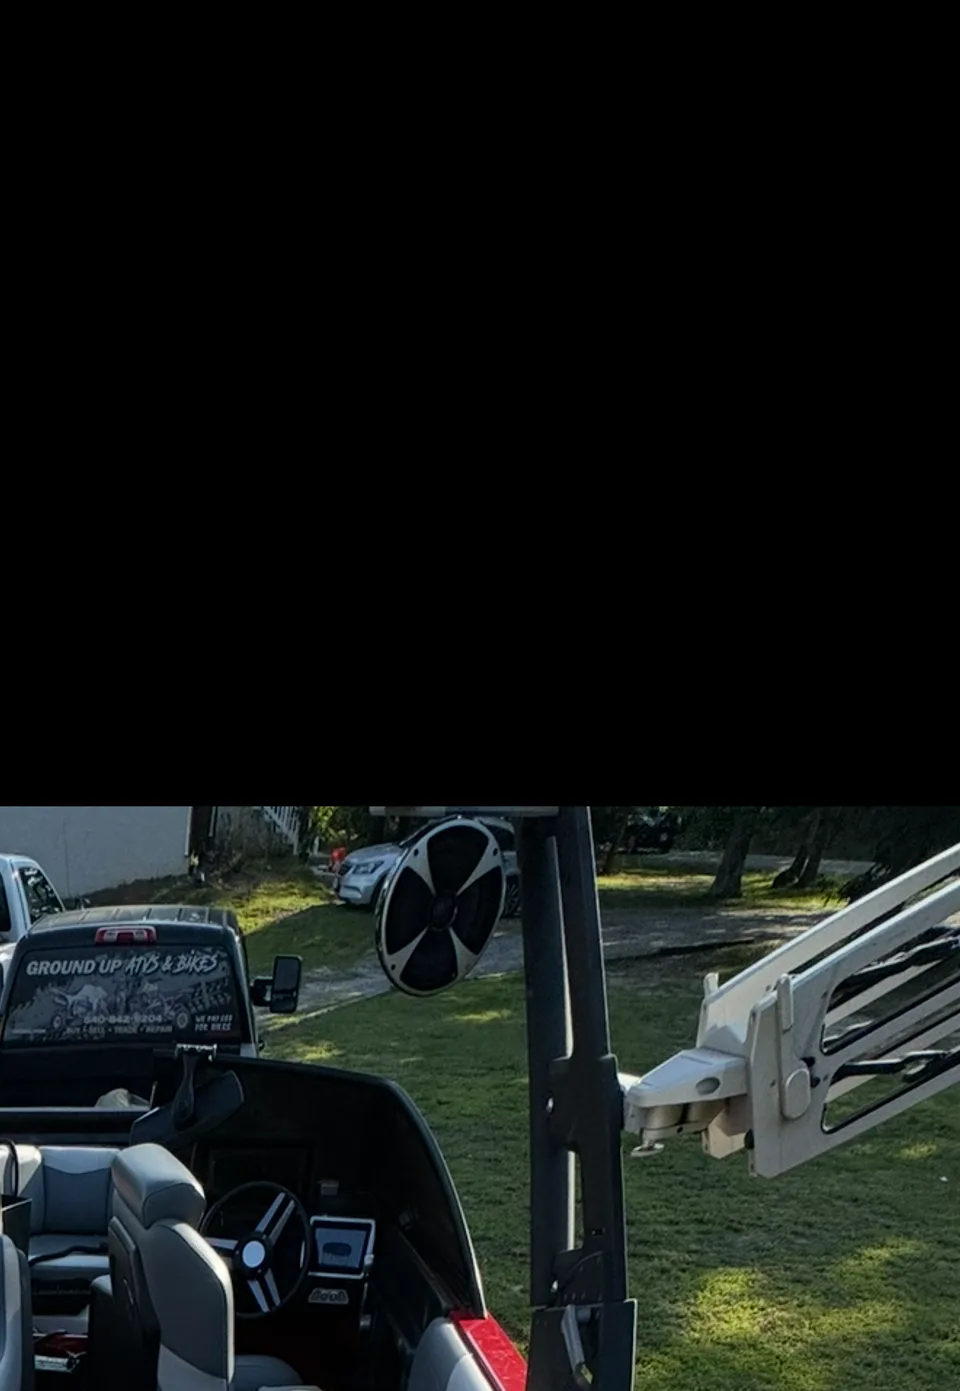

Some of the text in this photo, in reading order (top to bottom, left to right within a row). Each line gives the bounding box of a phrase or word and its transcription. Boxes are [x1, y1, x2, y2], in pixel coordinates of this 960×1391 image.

[26, 959, 96, 976] GROUND
[99, 958, 122, 974] UP
[162, 956, 172, 972] &
